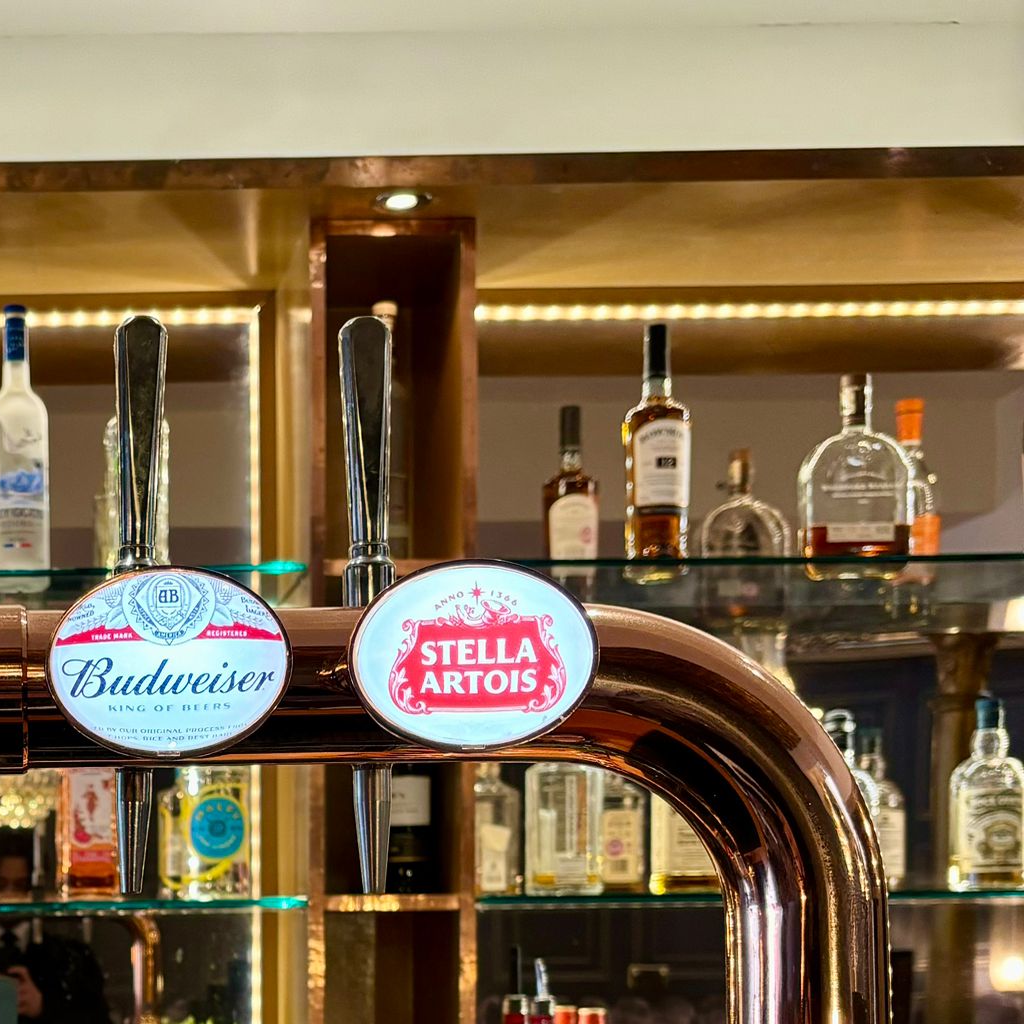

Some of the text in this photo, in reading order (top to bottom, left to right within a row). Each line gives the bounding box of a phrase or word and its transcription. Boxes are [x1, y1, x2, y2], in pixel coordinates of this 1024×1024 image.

[158, 588, 179, 604] AB
[434, 589, 518, 612] ANNO 1366
[91, 629, 248, 641] TRADE MARK REGISTERED
[420, 637, 539, 666] STELLA
[61, 656, 275, 699] Budweiser
[420, 669, 538, 695] ARTOIS
[108, 702, 231, 712] KING OF BEERS
